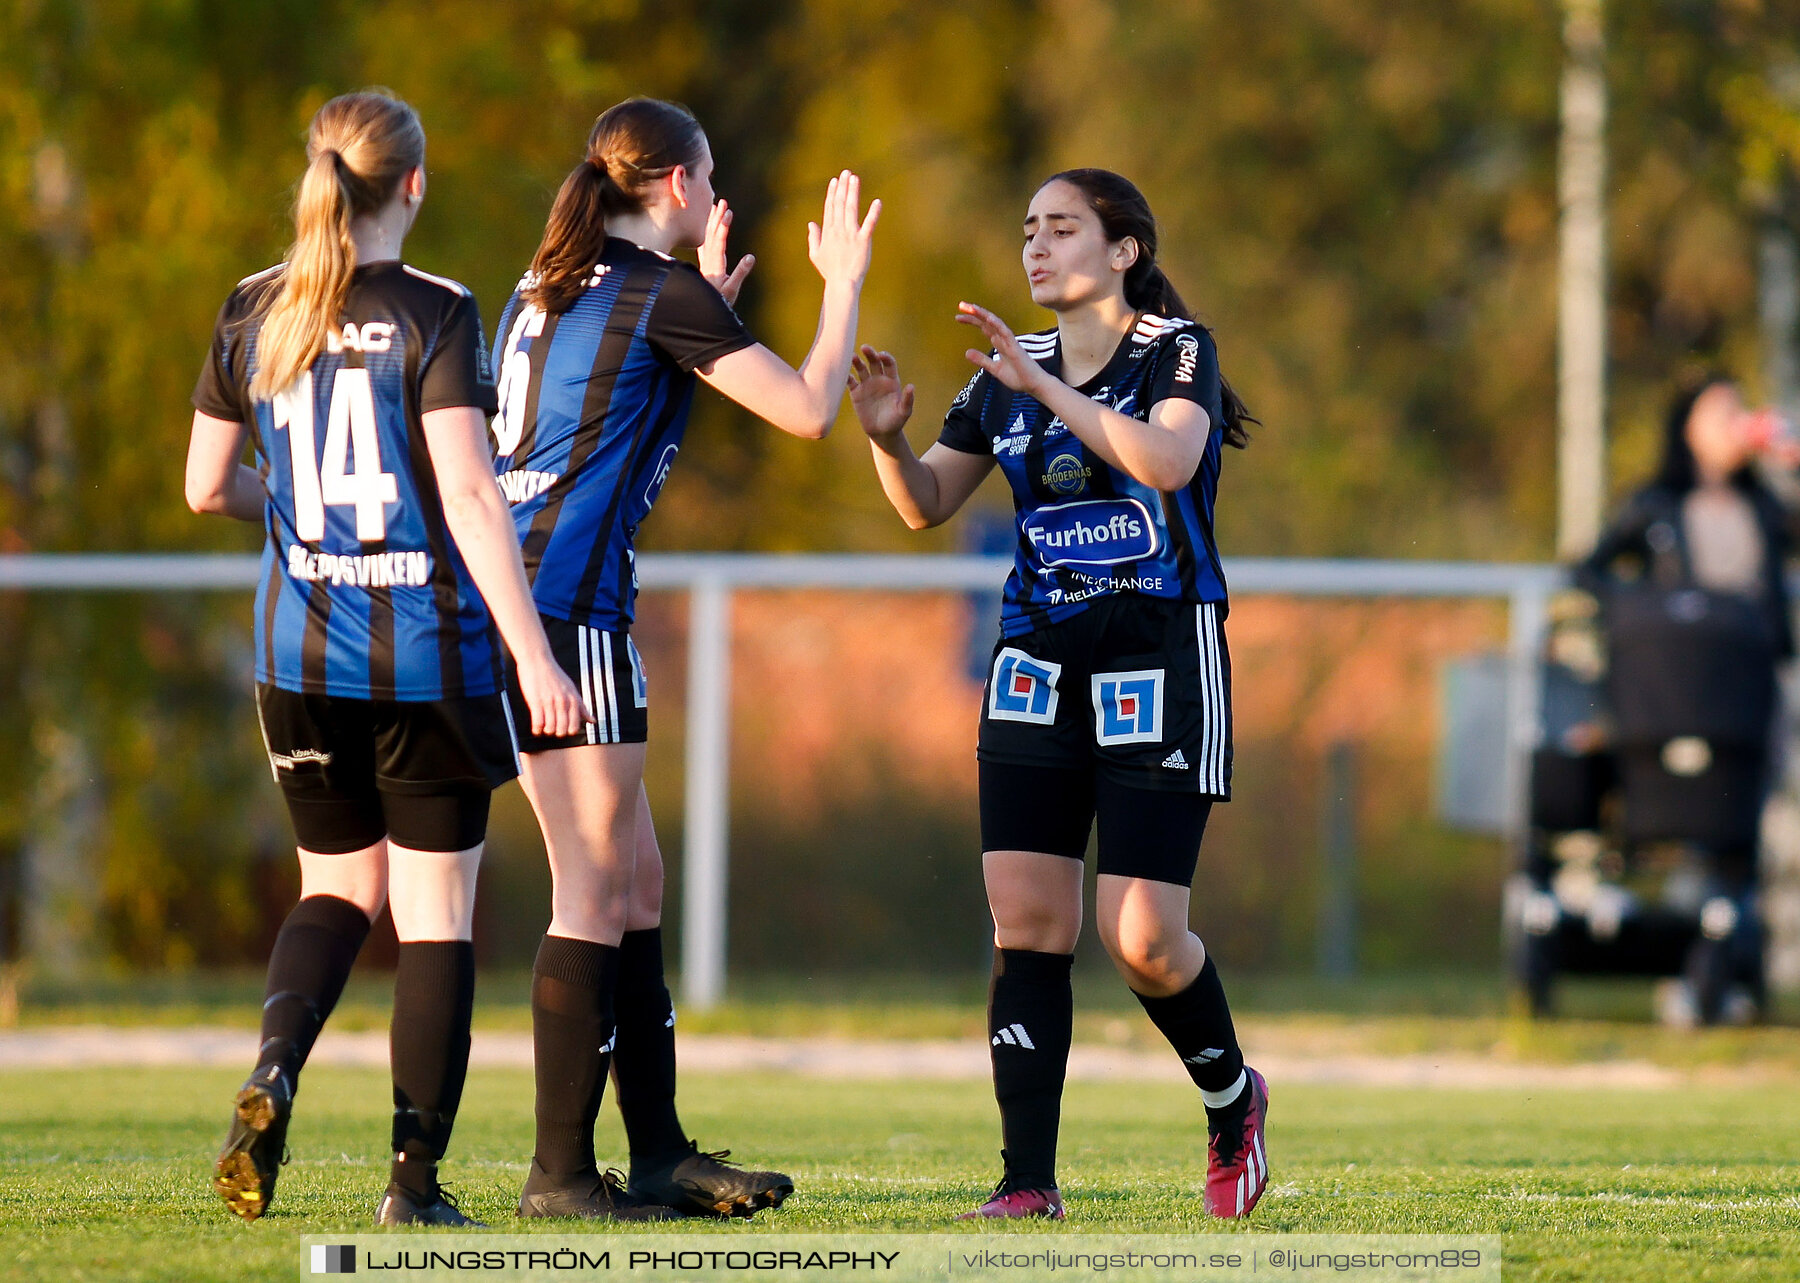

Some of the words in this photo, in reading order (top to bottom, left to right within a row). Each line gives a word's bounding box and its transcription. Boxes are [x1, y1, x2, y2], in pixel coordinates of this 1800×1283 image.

[491, 303, 548, 456] 6
[272, 367, 399, 542] 14
[1028, 514, 1142, 549] Furhoffs
[1161, 760, 1189, 770] adidas
